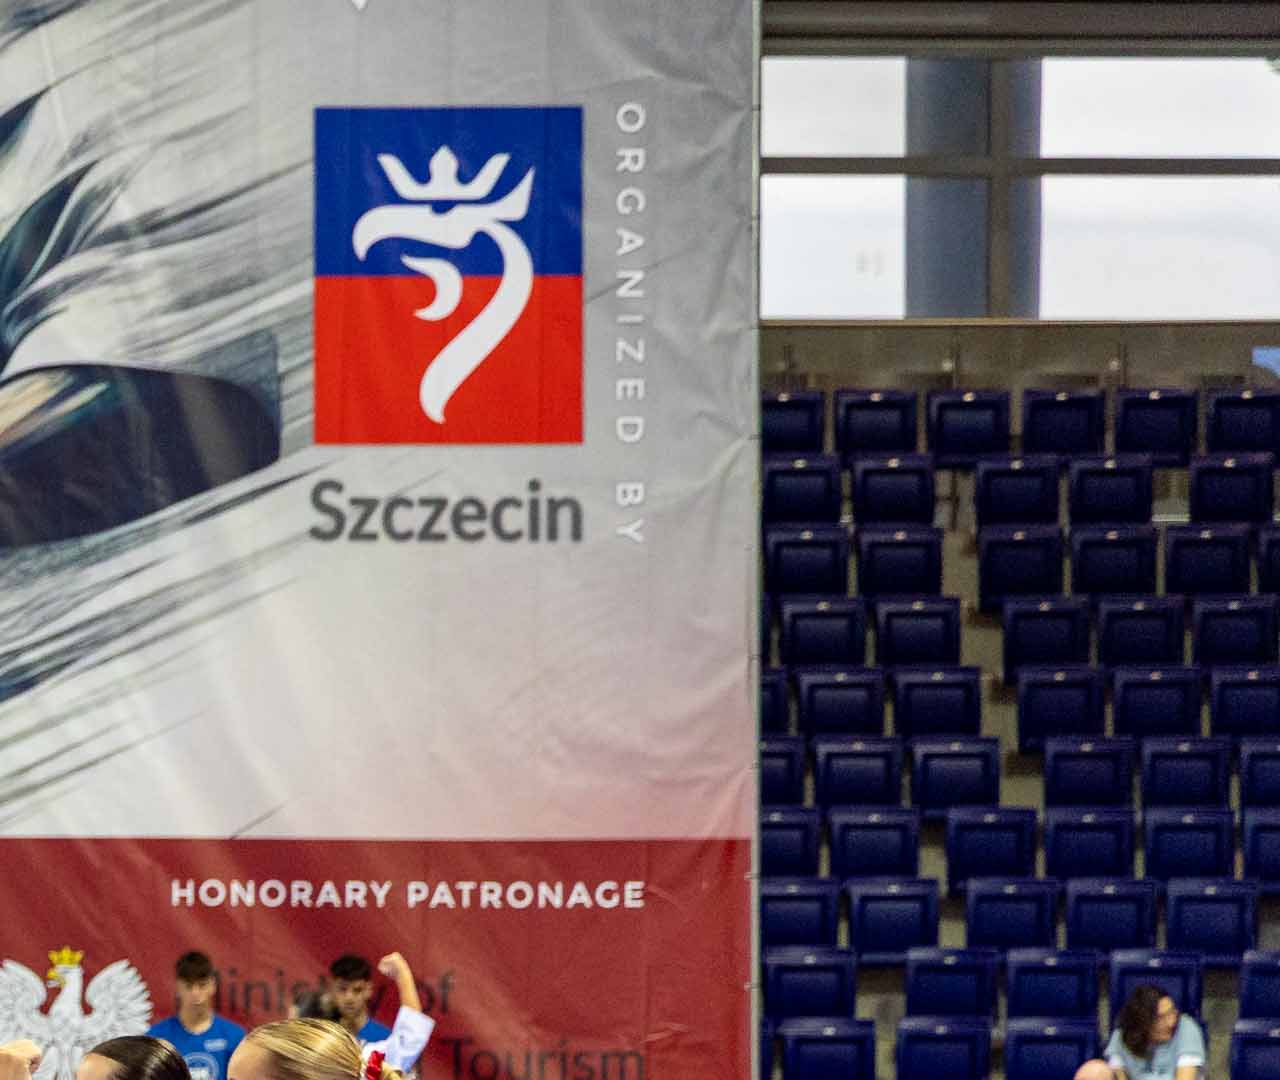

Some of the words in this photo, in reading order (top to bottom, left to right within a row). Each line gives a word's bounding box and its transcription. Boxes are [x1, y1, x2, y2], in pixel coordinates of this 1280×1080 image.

[615, 101, 646, 444] ORGANIZED
[308, 478, 584, 544] Szczecin
[615, 481, 645, 544] BY
[169, 878, 393, 908] HONORARY
[407, 880, 646, 910] PATRONAGE
